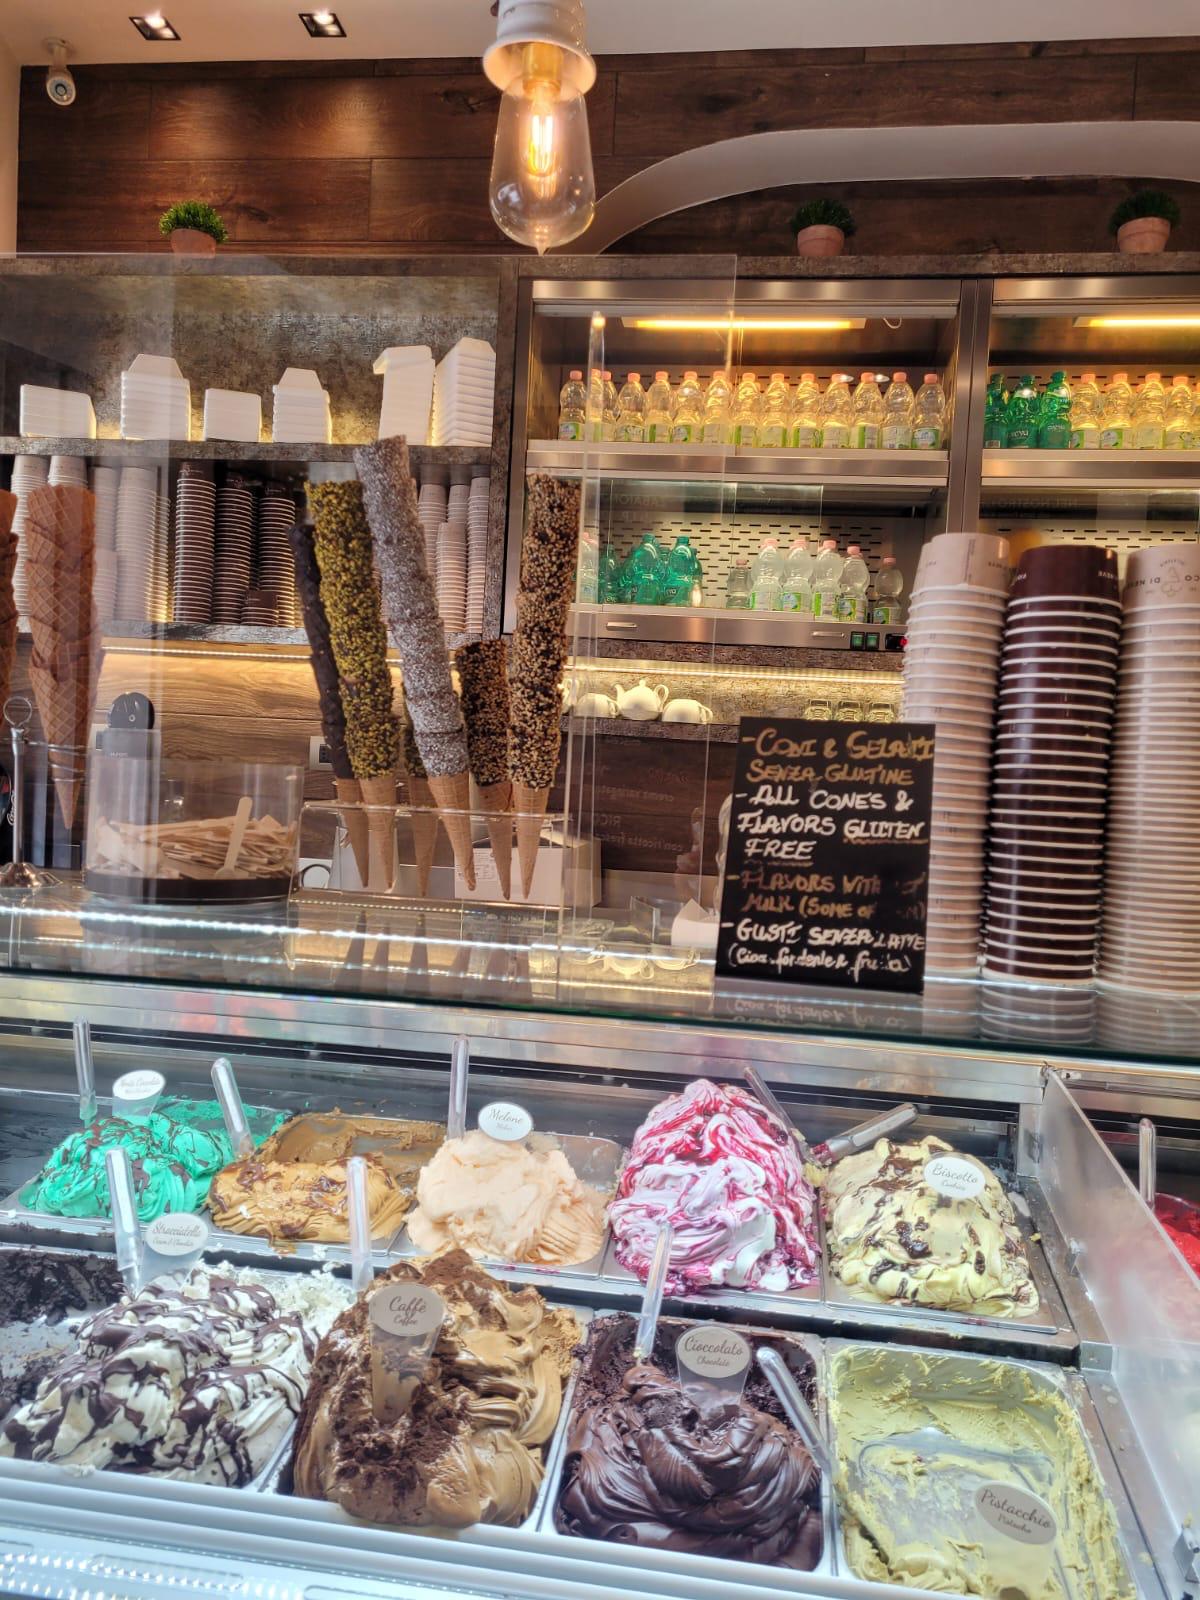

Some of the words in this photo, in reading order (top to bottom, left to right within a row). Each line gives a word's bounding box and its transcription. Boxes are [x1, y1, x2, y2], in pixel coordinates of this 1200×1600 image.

[746, 759, 821, 783] SENZA
[824, 764, 915, 786] GLUTINE
[809, 789, 888, 812] CONES
[894, 790, 915, 812] &
[737, 809, 836, 836] FLAVORS
[843, 818, 926, 840] GLUTEN
[744, 838, 817, 860] FREE
[684, 1335, 744, 1355] Cioccolato
[980, 1488, 1052, 1529] Pistacchio
